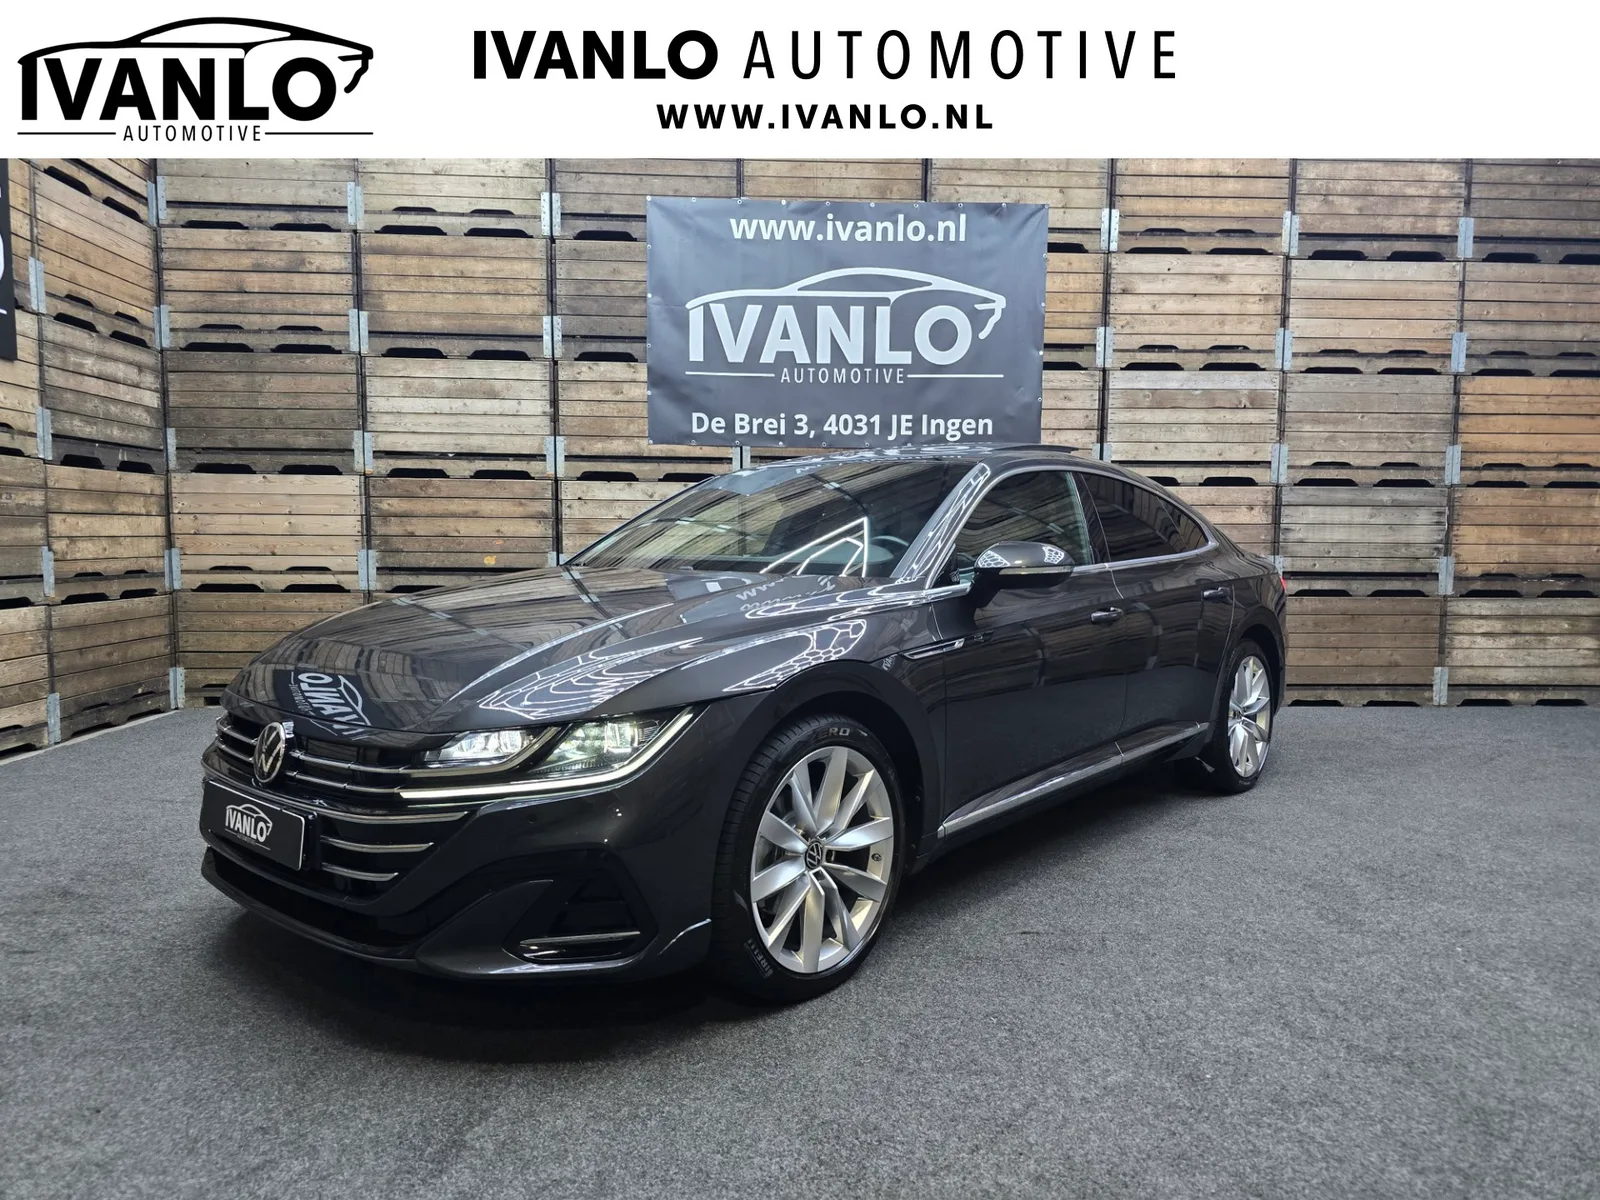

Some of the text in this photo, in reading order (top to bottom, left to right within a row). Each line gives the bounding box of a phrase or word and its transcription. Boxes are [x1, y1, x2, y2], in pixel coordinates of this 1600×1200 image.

[729, 213, 967, 243] www.ivanlo.nl
[688, 302, 973, 366] IVANLO
[780, 367, 905, 384] AUTOMOTIVE
[691, 412, 993, 442] De Brei 3, 4031 JE Ingen
[225, 808, 267, 843] IVANLO
